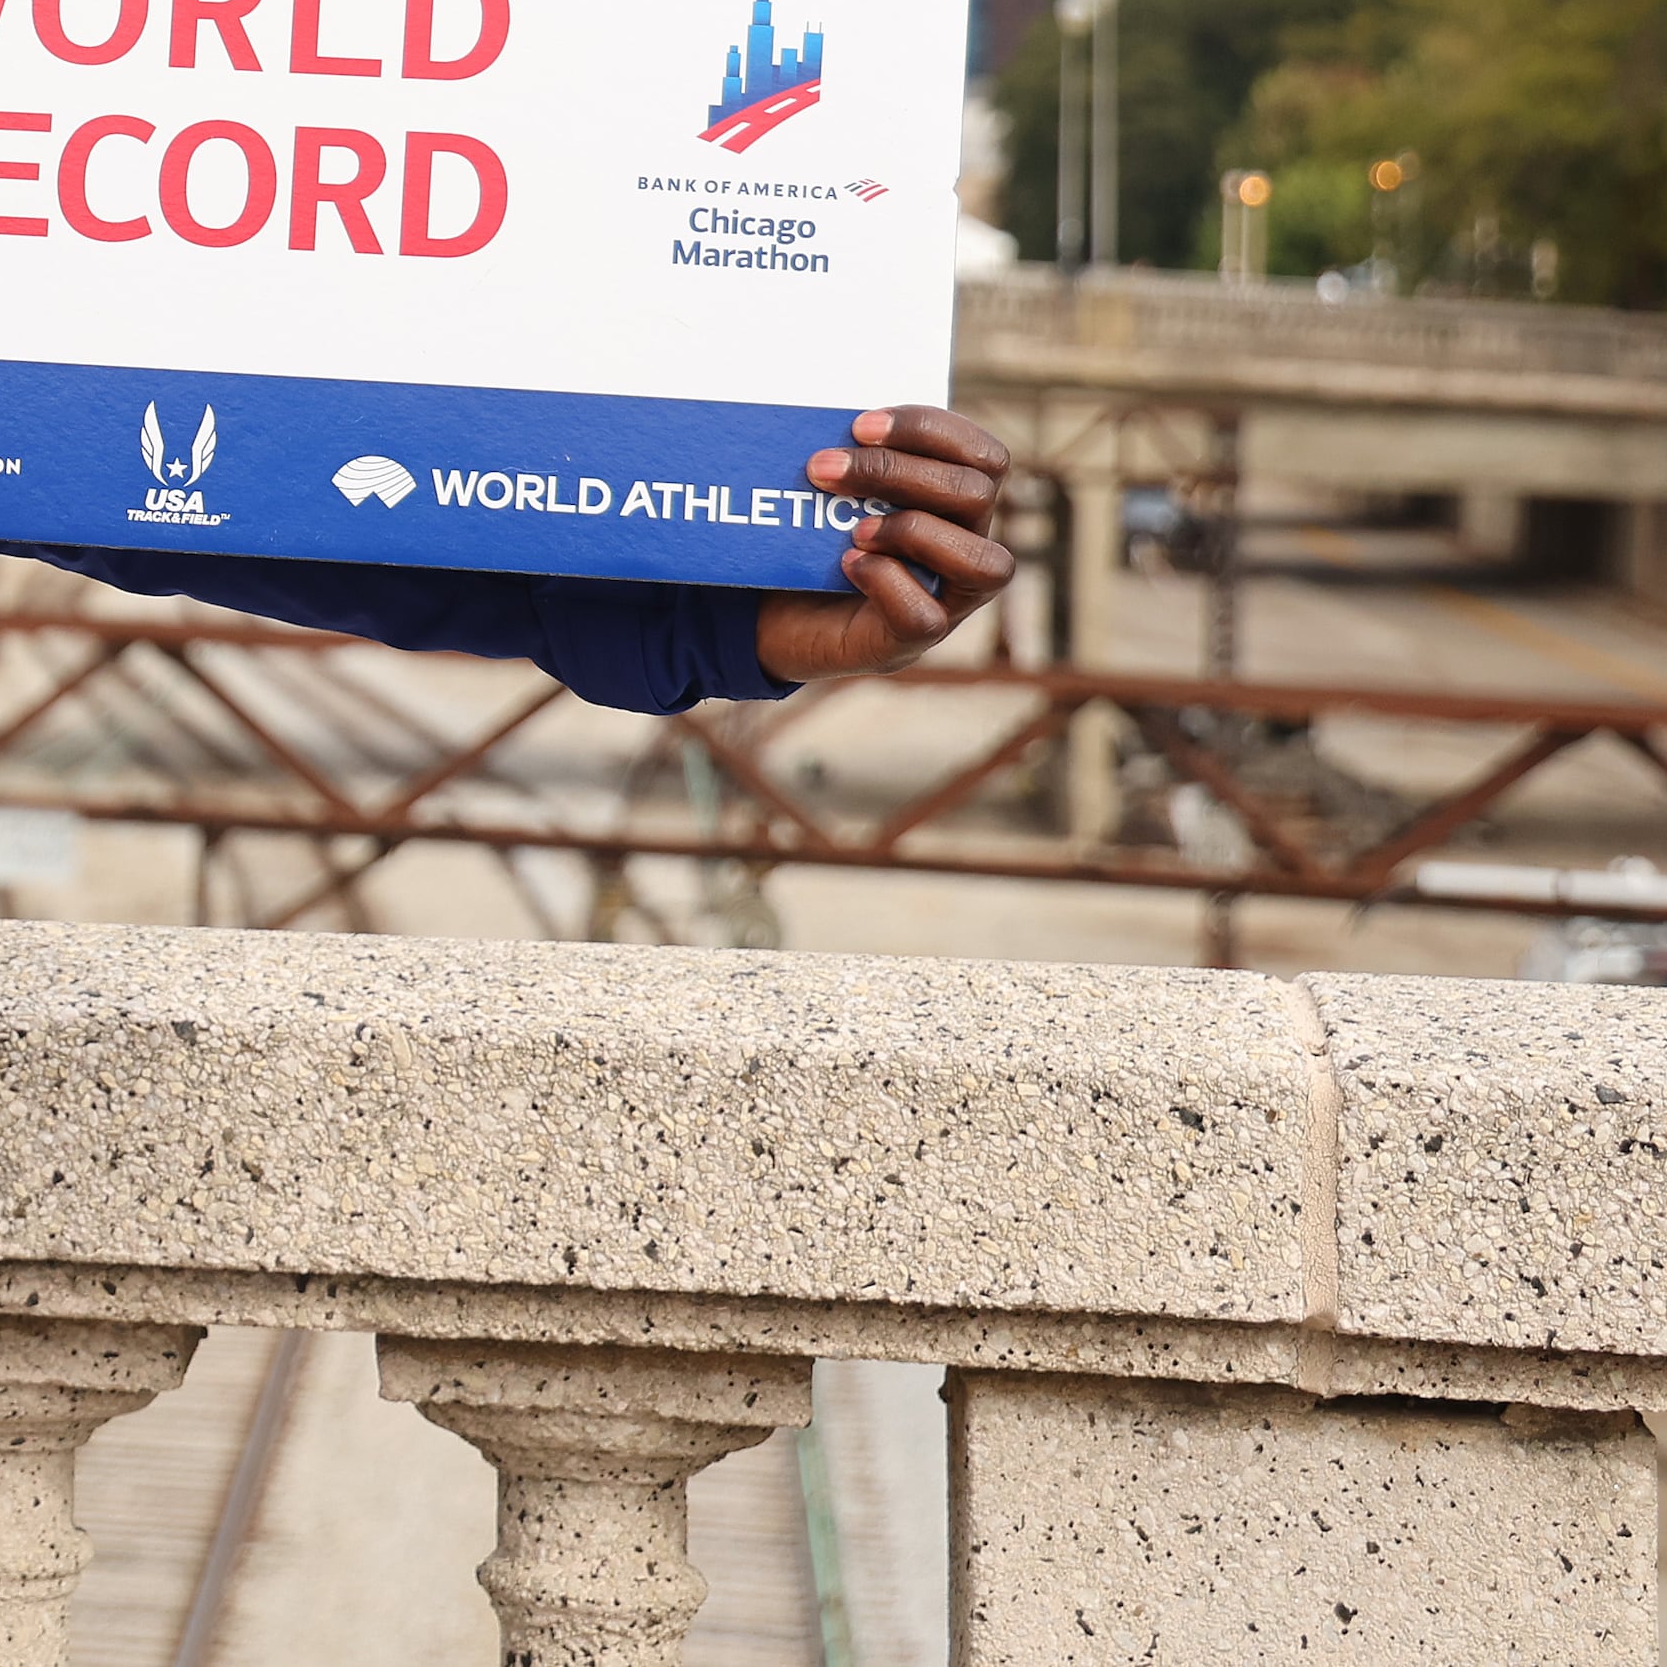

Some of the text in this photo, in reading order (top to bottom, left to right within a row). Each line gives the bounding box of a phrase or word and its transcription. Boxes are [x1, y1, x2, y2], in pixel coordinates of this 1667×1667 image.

[637, 176, 838, 200] BANK OF AMERICA
[688, 207, 816, 245] Chicago
[671, 239, 829, 273] Marathon
[144, 487, 205, 514] USA
[431, 467, 612, 515] WORLD
